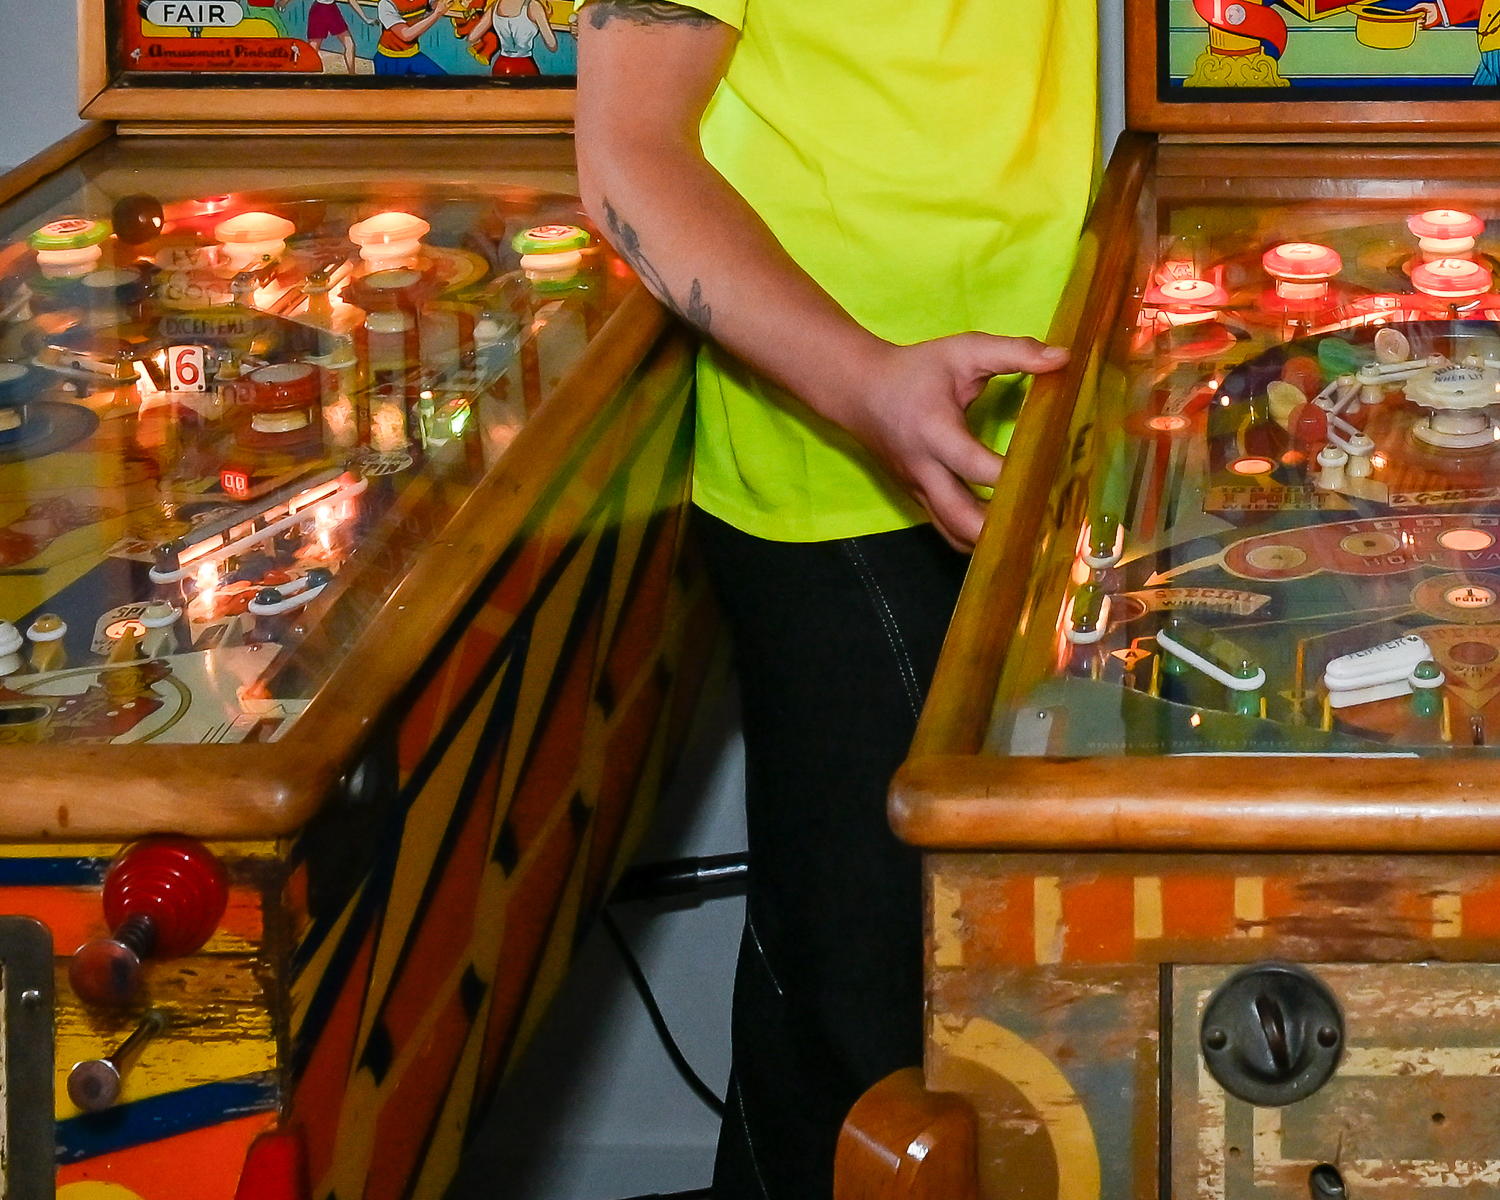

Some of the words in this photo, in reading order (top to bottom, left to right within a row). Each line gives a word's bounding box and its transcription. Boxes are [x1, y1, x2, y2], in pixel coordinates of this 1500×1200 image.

[163, 4, 225, 23] FAIR
[175, 349, 199, 385] 6
[112, 607, 146, 619] SPI
